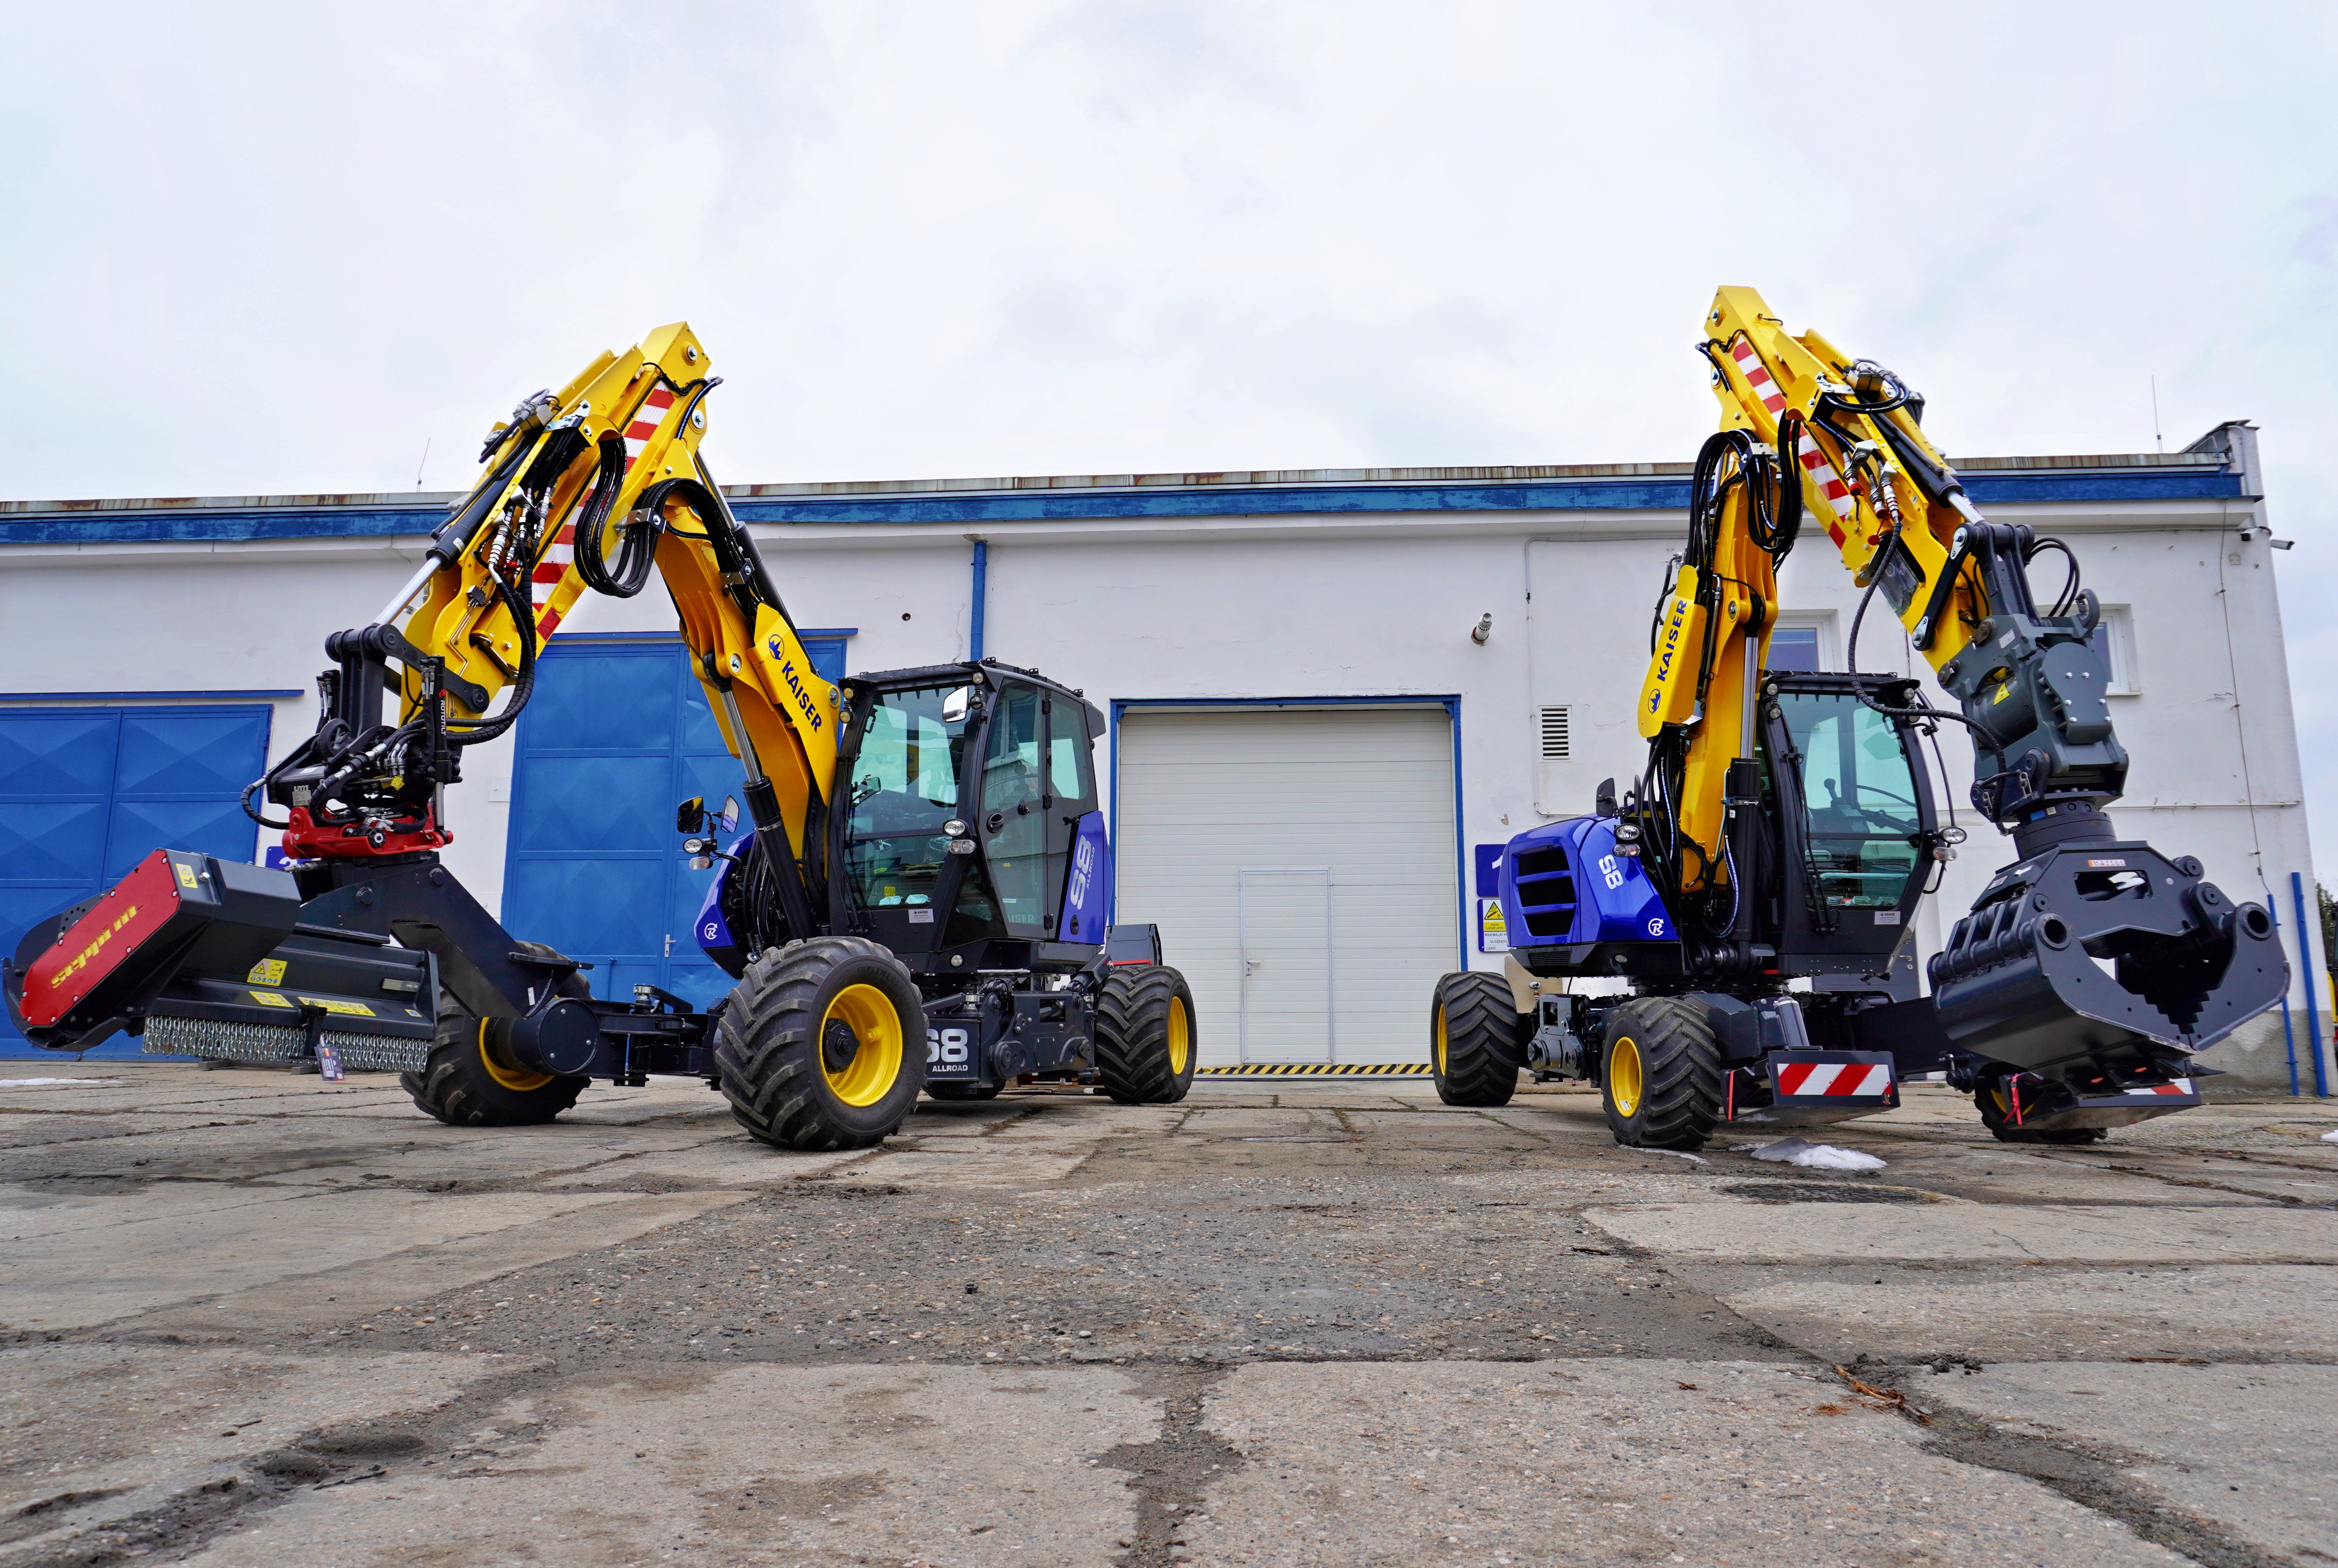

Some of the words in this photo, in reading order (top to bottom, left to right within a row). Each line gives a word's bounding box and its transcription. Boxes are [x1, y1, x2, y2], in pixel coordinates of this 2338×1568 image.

[1657, 600, 1688, 682] KAISER
[782, 660, 822, 733] KAISER
[1070, 834, 1091, 910] S8
[1087, 847, 1095, 889] ALLROAD
[1598, 854, 1624, 889] S8
[1008, 914, 1034, 923] ISER
